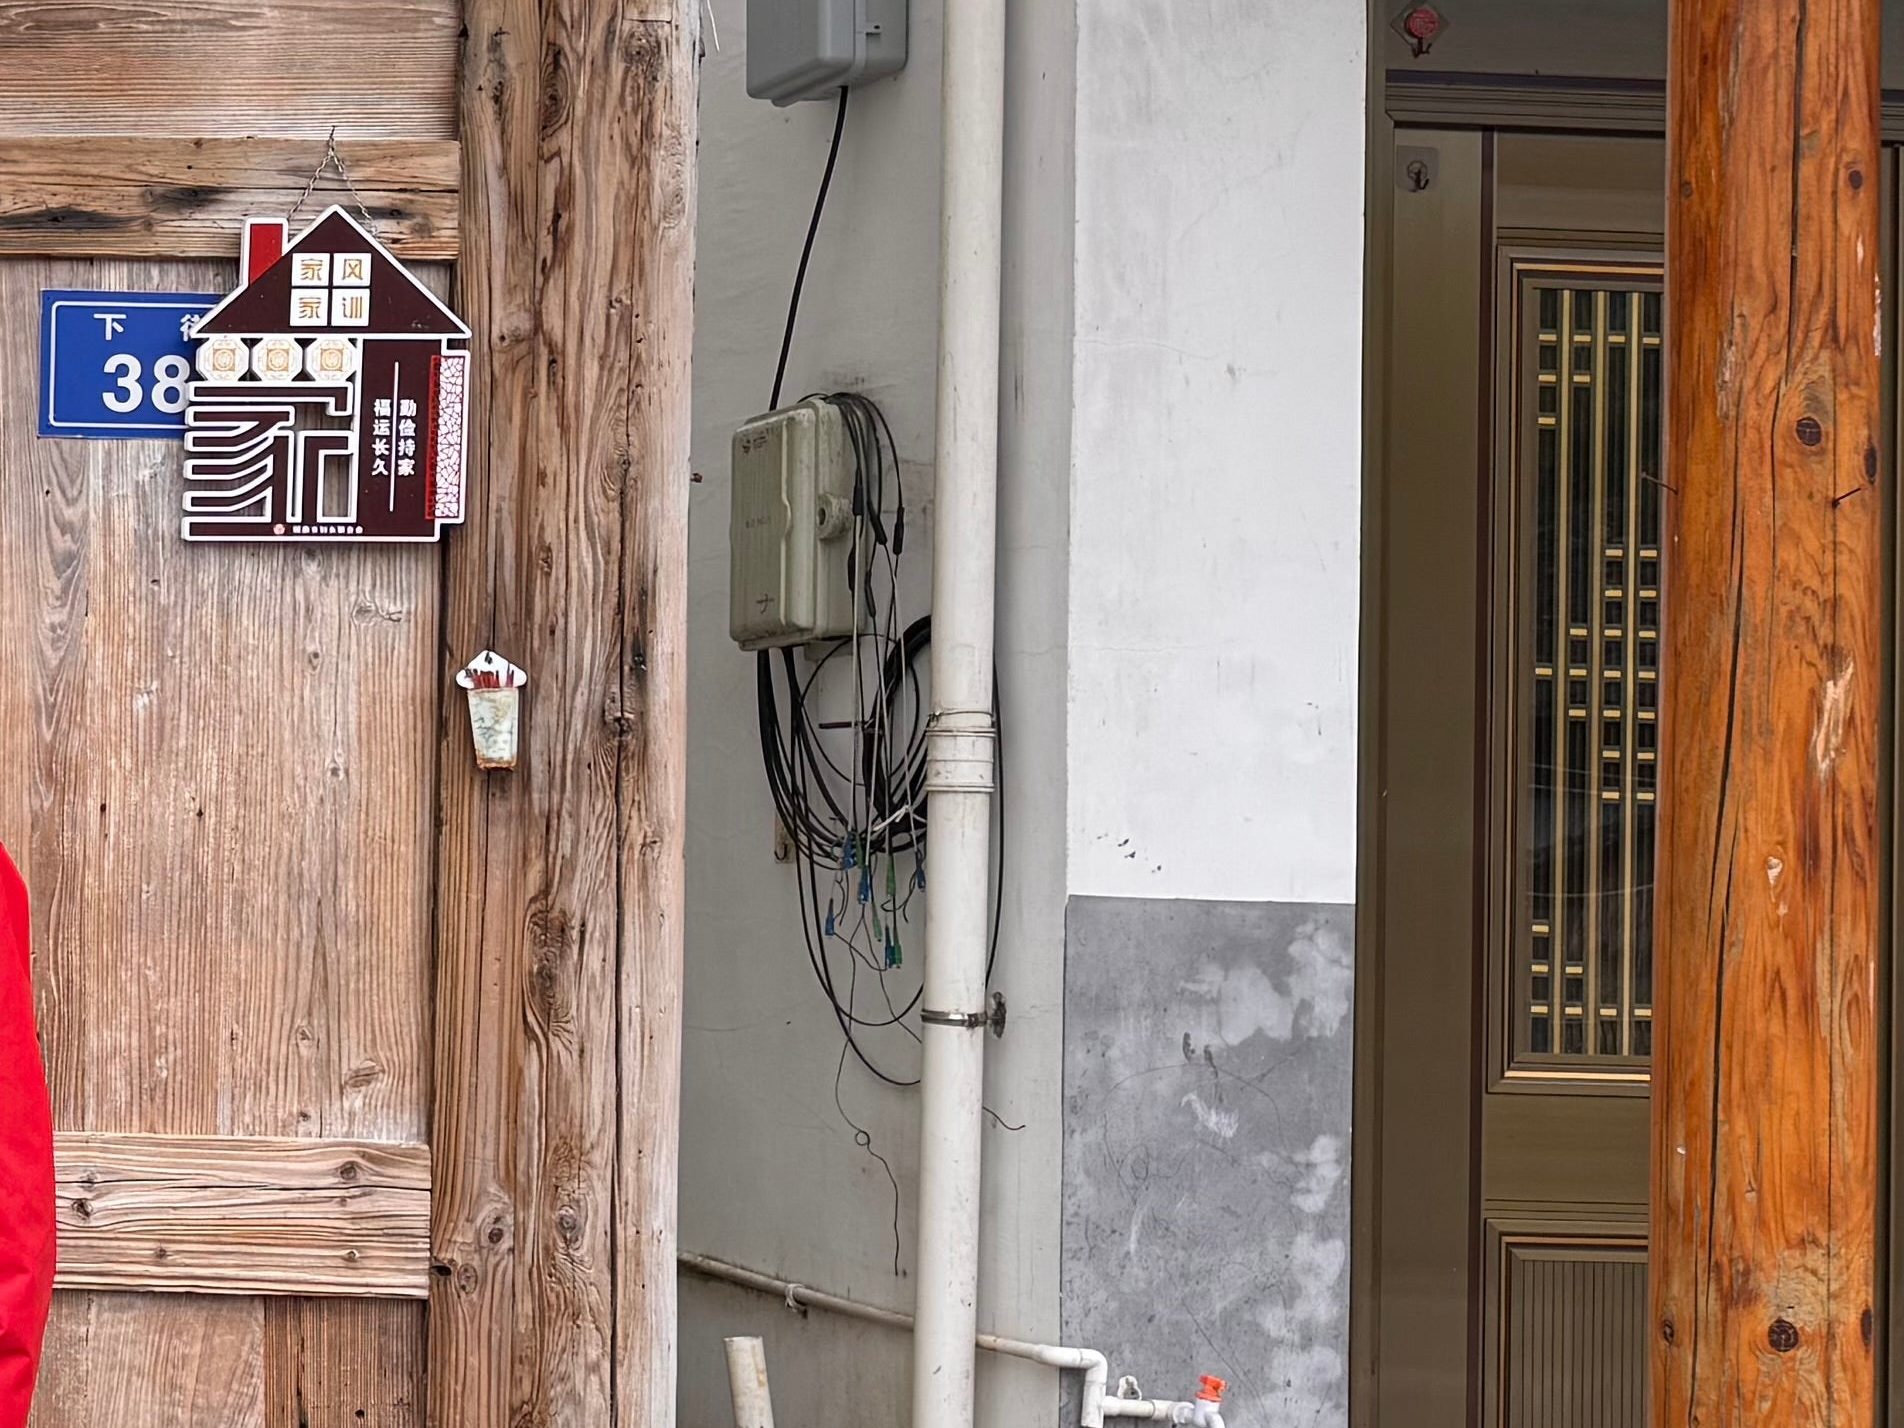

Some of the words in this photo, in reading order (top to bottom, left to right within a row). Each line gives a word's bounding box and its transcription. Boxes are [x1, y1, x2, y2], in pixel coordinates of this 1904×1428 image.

[300, 258, 363, 281] 家风
[298, 296, 363, 319] 家训
[102, 353, 191, 414] 38
